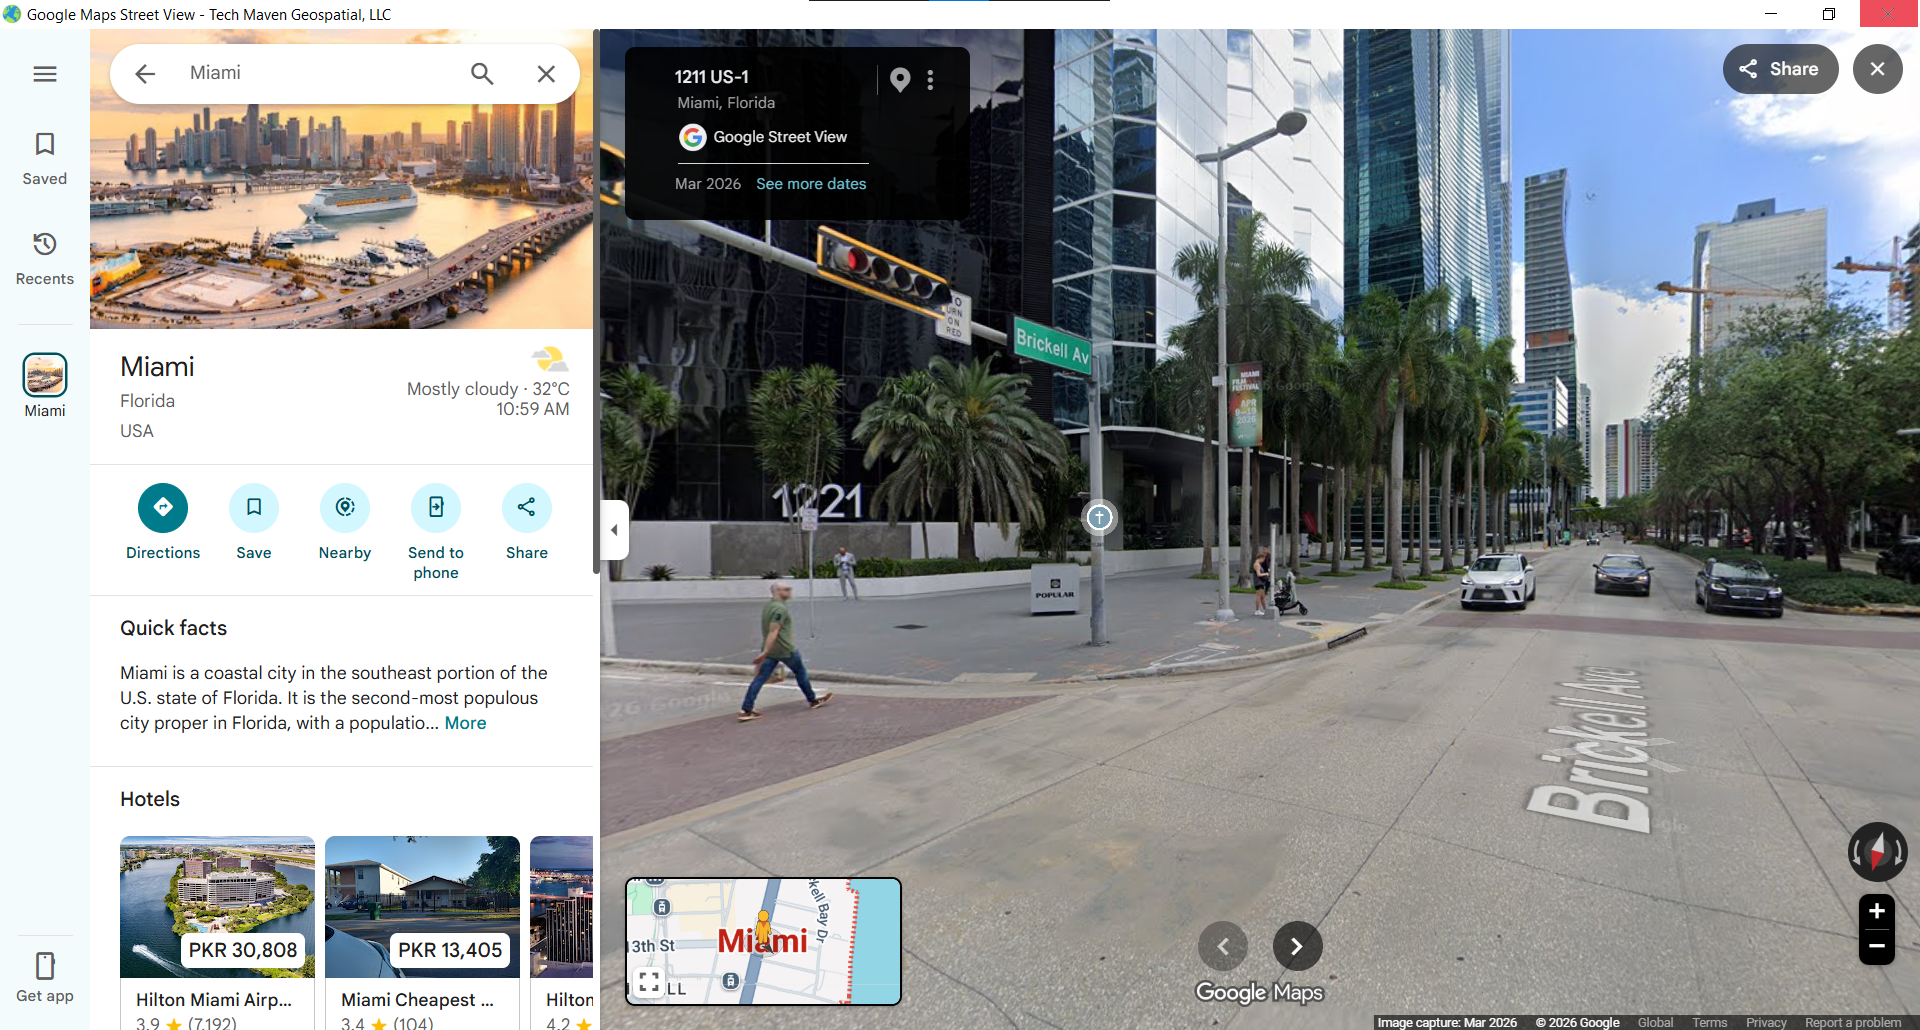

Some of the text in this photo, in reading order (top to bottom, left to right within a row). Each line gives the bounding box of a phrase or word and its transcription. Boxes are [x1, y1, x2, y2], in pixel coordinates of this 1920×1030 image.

[27, 9, 76, 23] Google
[81, 9, 116, 23] Maps
[120, 9, 159, 20] Street
[163, 9, 195, 20] View
[209, 9, 239, 20] Tech
[244, 9, 287, 20] Maven
[291, 9, 365, 23] Geospatial,
[370, 9, 391, 20] LLC
[191, 64, 240, 79] Miami
[23, 172, 67, 184] Saved
[16, 273, 74, 284] Recents
[947, 316, 960, 327] ON
[946, 326, 962, 337] RED
[1017, 327, 1090, 365] Brickell Av
[122, 356, 194, 377] Miami
[1240, 370, 1260, 378] MIAMI
[408, 381, 460, 399] Mostly
[465, 381, 518, 399] cloudy
[533, 382, 569, 395] 32°C
[1232, 383, 1260, 392] FESTIVAL
[121, 393, 175, 407] Florida
[1241, 398, 1257, 408] APR
[25, 404, 65, 416] Miami
[497, 402, 569, 415] 10:59 AM
[1237, 416, 1257, 425] 2026
[121, 424, 154, 437] USA
[772, 482, 861, 518] 1221
[127, 546, 200, 558] Directions
[237, 547, 271, 558] Save
[319, 546, 371, 561] Nearby
[408, 546, 464, 558] Send to
[506, 546, 548, 558] Share
[414, 566, 458, 581] phone
[1035, 591, 1075, 599] POPULAR
[121, 619, 227, 636] Quick facts
[121, 665, 547, 683] Miami is a coastal city in the southeast portion of the
[121, 690, 538, 708] U.S. state of Florida. It is the second-most populous
[120, 715, 149, 733] city
[155, 720, 208, 733] proper
[214, 715, 226, 729] in
[233, 715, 291, 731] Florida,
[296, 715, 329, 729] with
[335, 720, 344, 729] a
[446, 716, 486, 729] More
[121, 790, 180, 806] Hotels
[808, 879, 830, 944] kell Bay Dr
[660, 939, 675, 952] St
[718, 927, 808, 954] Miami
[190, 942, 297, 960] PKR 30,808
[399, 942, 502, 960] PKR 13,405
[16, 990, 74, 1004] Get app
[137, 992, 185, 1006] Hilton
[191, 992, 239, 1006] Miami
[342, 992, 390, 1006] Miami
[395, 992, 475, 1010] Cheapest
[547, 992, 592, 1006] Hilton
[394, 1017, 433, 1030] (104)
